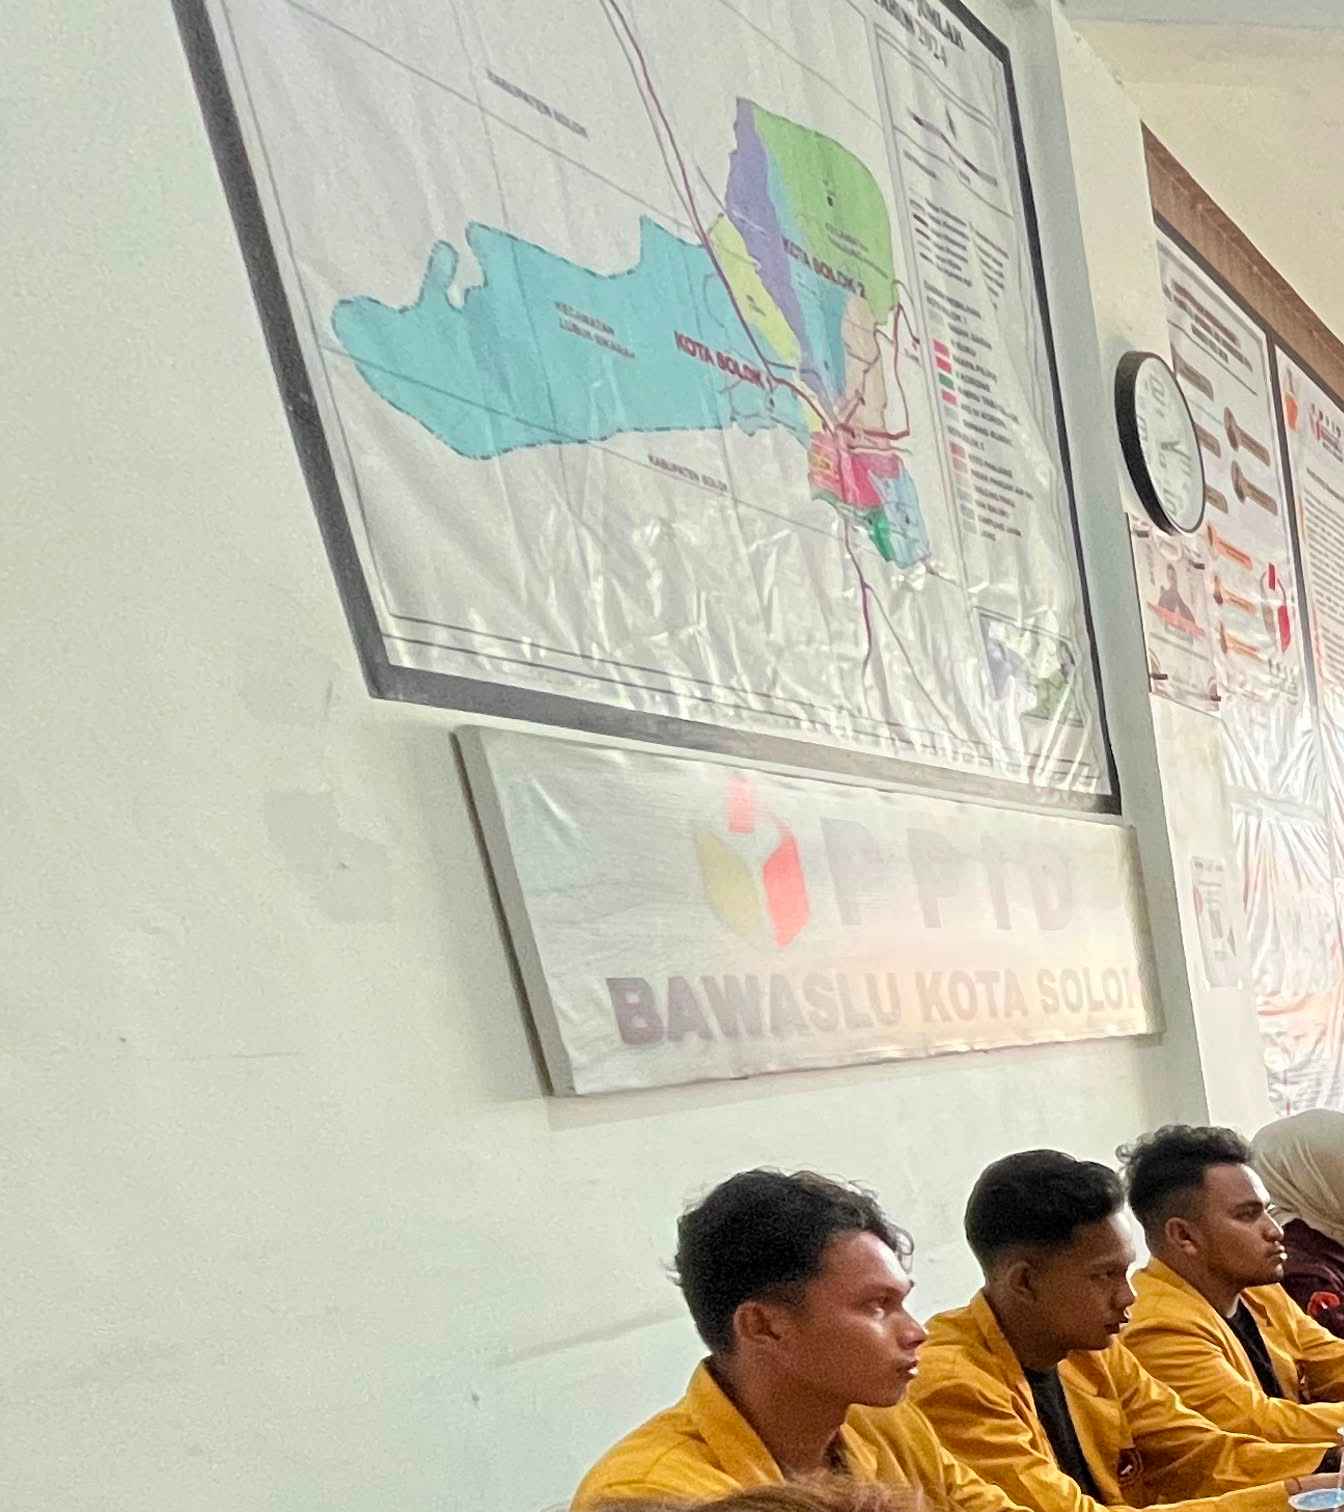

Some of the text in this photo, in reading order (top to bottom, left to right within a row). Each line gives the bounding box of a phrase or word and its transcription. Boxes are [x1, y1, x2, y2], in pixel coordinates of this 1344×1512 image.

[673, 329, 717, 367] KOTA
[606, 972, 902, 1046] BAWASLU
[913, 967, 1029, 1024] KOTA
